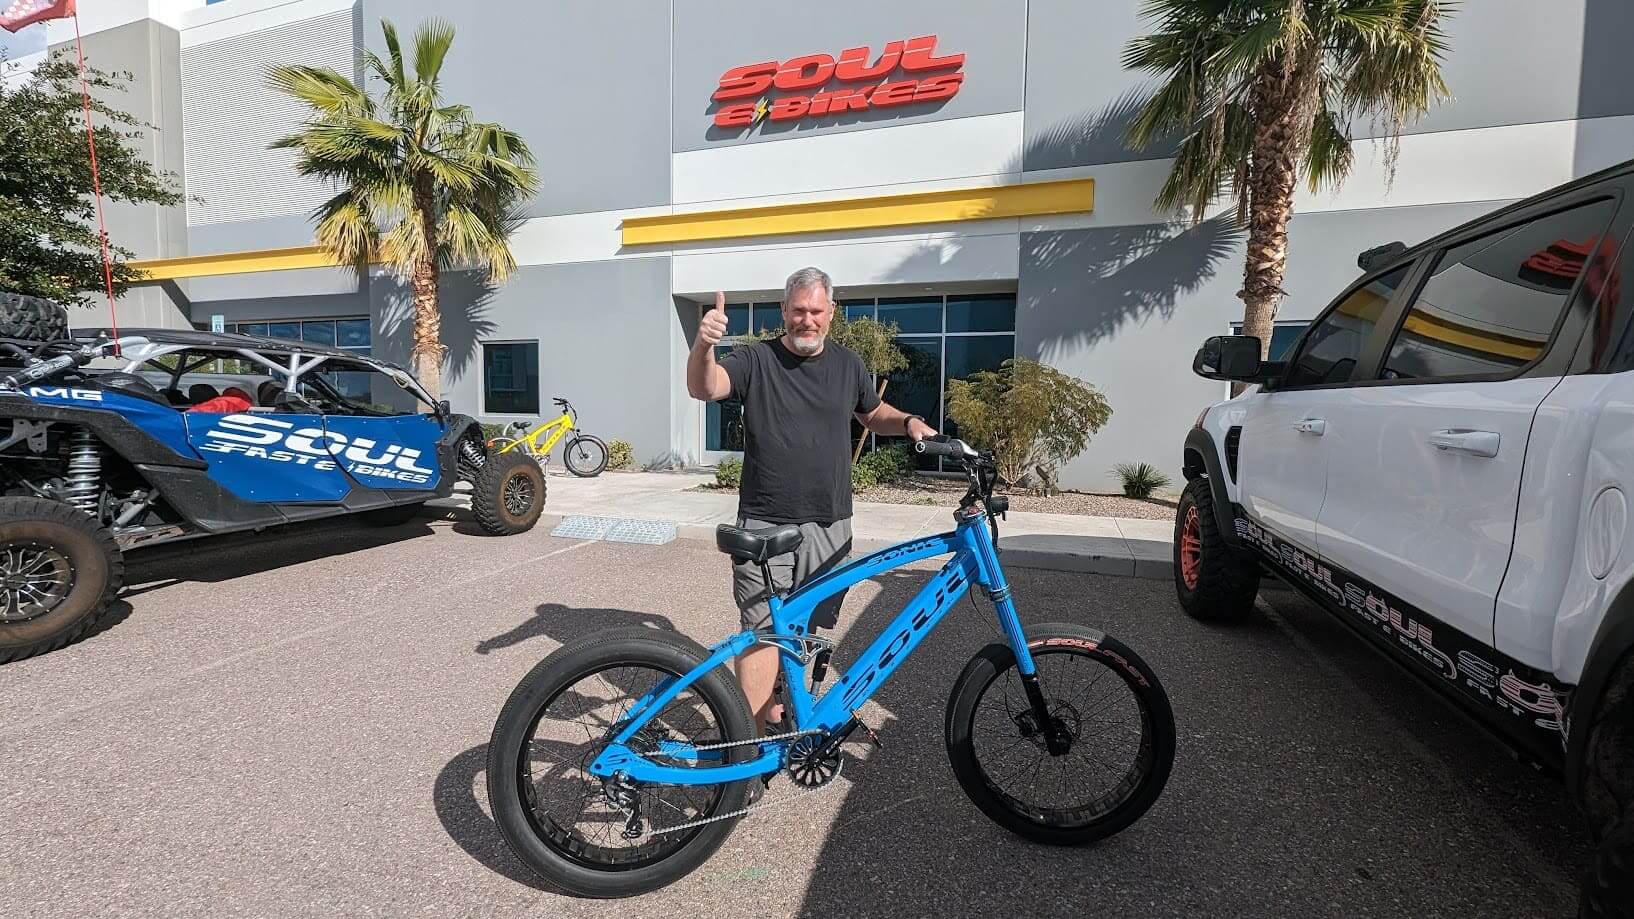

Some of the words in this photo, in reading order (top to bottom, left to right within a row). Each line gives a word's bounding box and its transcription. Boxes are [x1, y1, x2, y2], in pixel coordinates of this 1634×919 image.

[713, 35, 966, 102] SOUL
[199, 441, 316, 465] FAST
[206, 414, 433, 475] SOUL
[842, 565, 977, 711] SOUL
[1344, 580, 1458, 681] SOUL
[1350, 603, 1379, 626] FAST
[1398, 634, 1445, 669] BIKES
[1466, 677, 1526, 716] FAST
